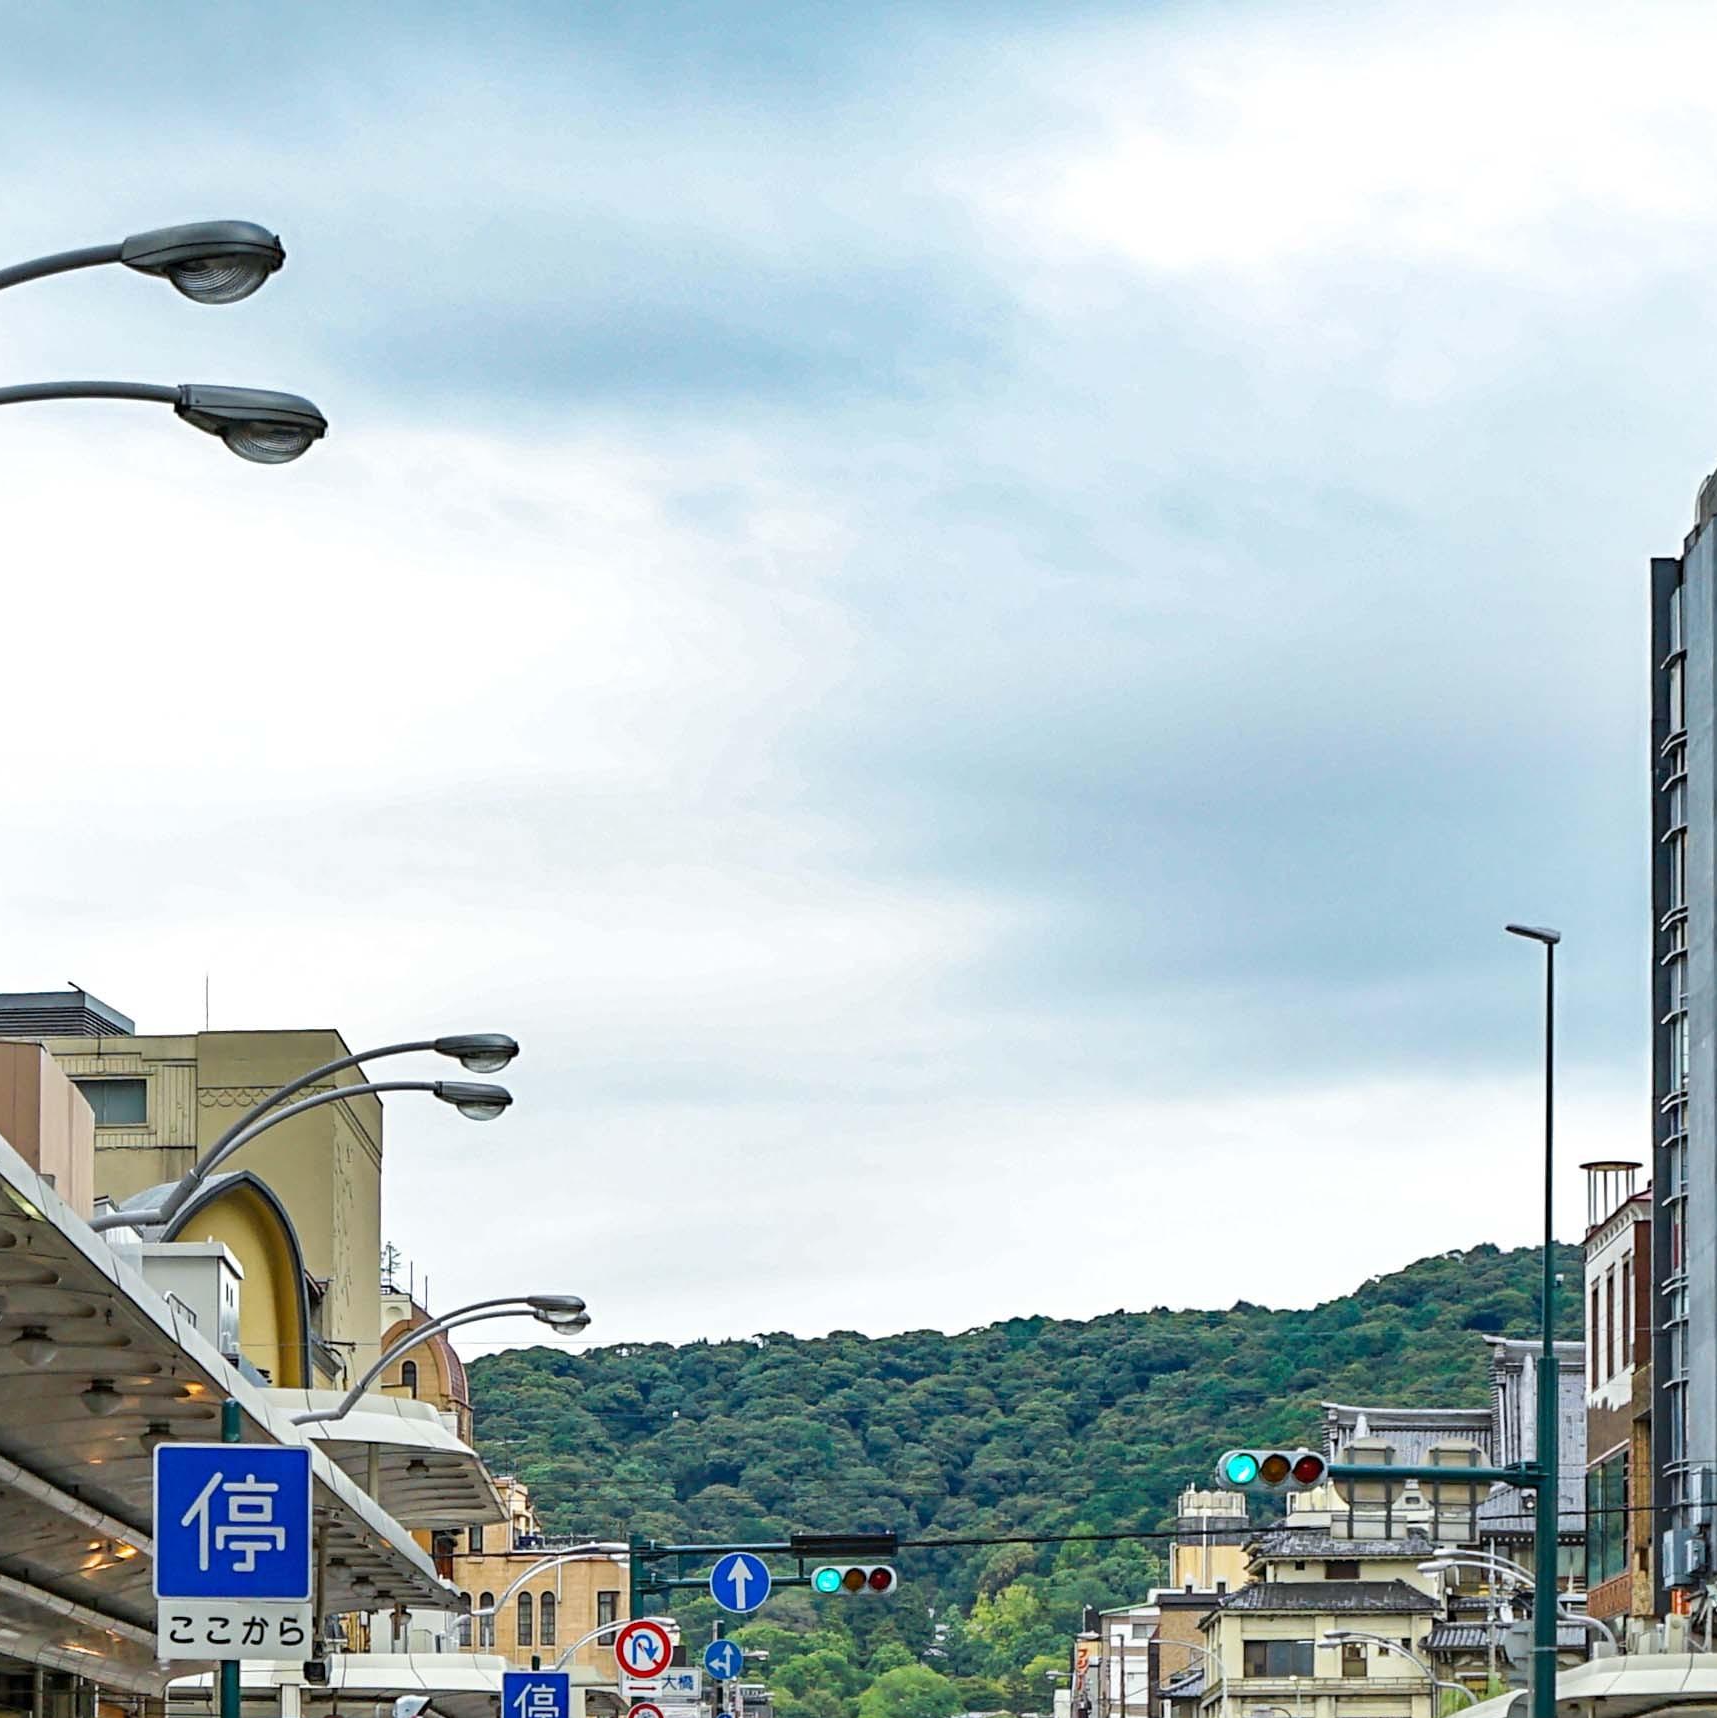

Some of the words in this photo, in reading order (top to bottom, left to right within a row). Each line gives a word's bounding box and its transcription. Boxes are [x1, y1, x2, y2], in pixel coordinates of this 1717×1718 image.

[181, 1472, 286, 1572] 停
[170, 1616, 305, 1646] ここから
[661, 1674, 694, 1691] 大橋
